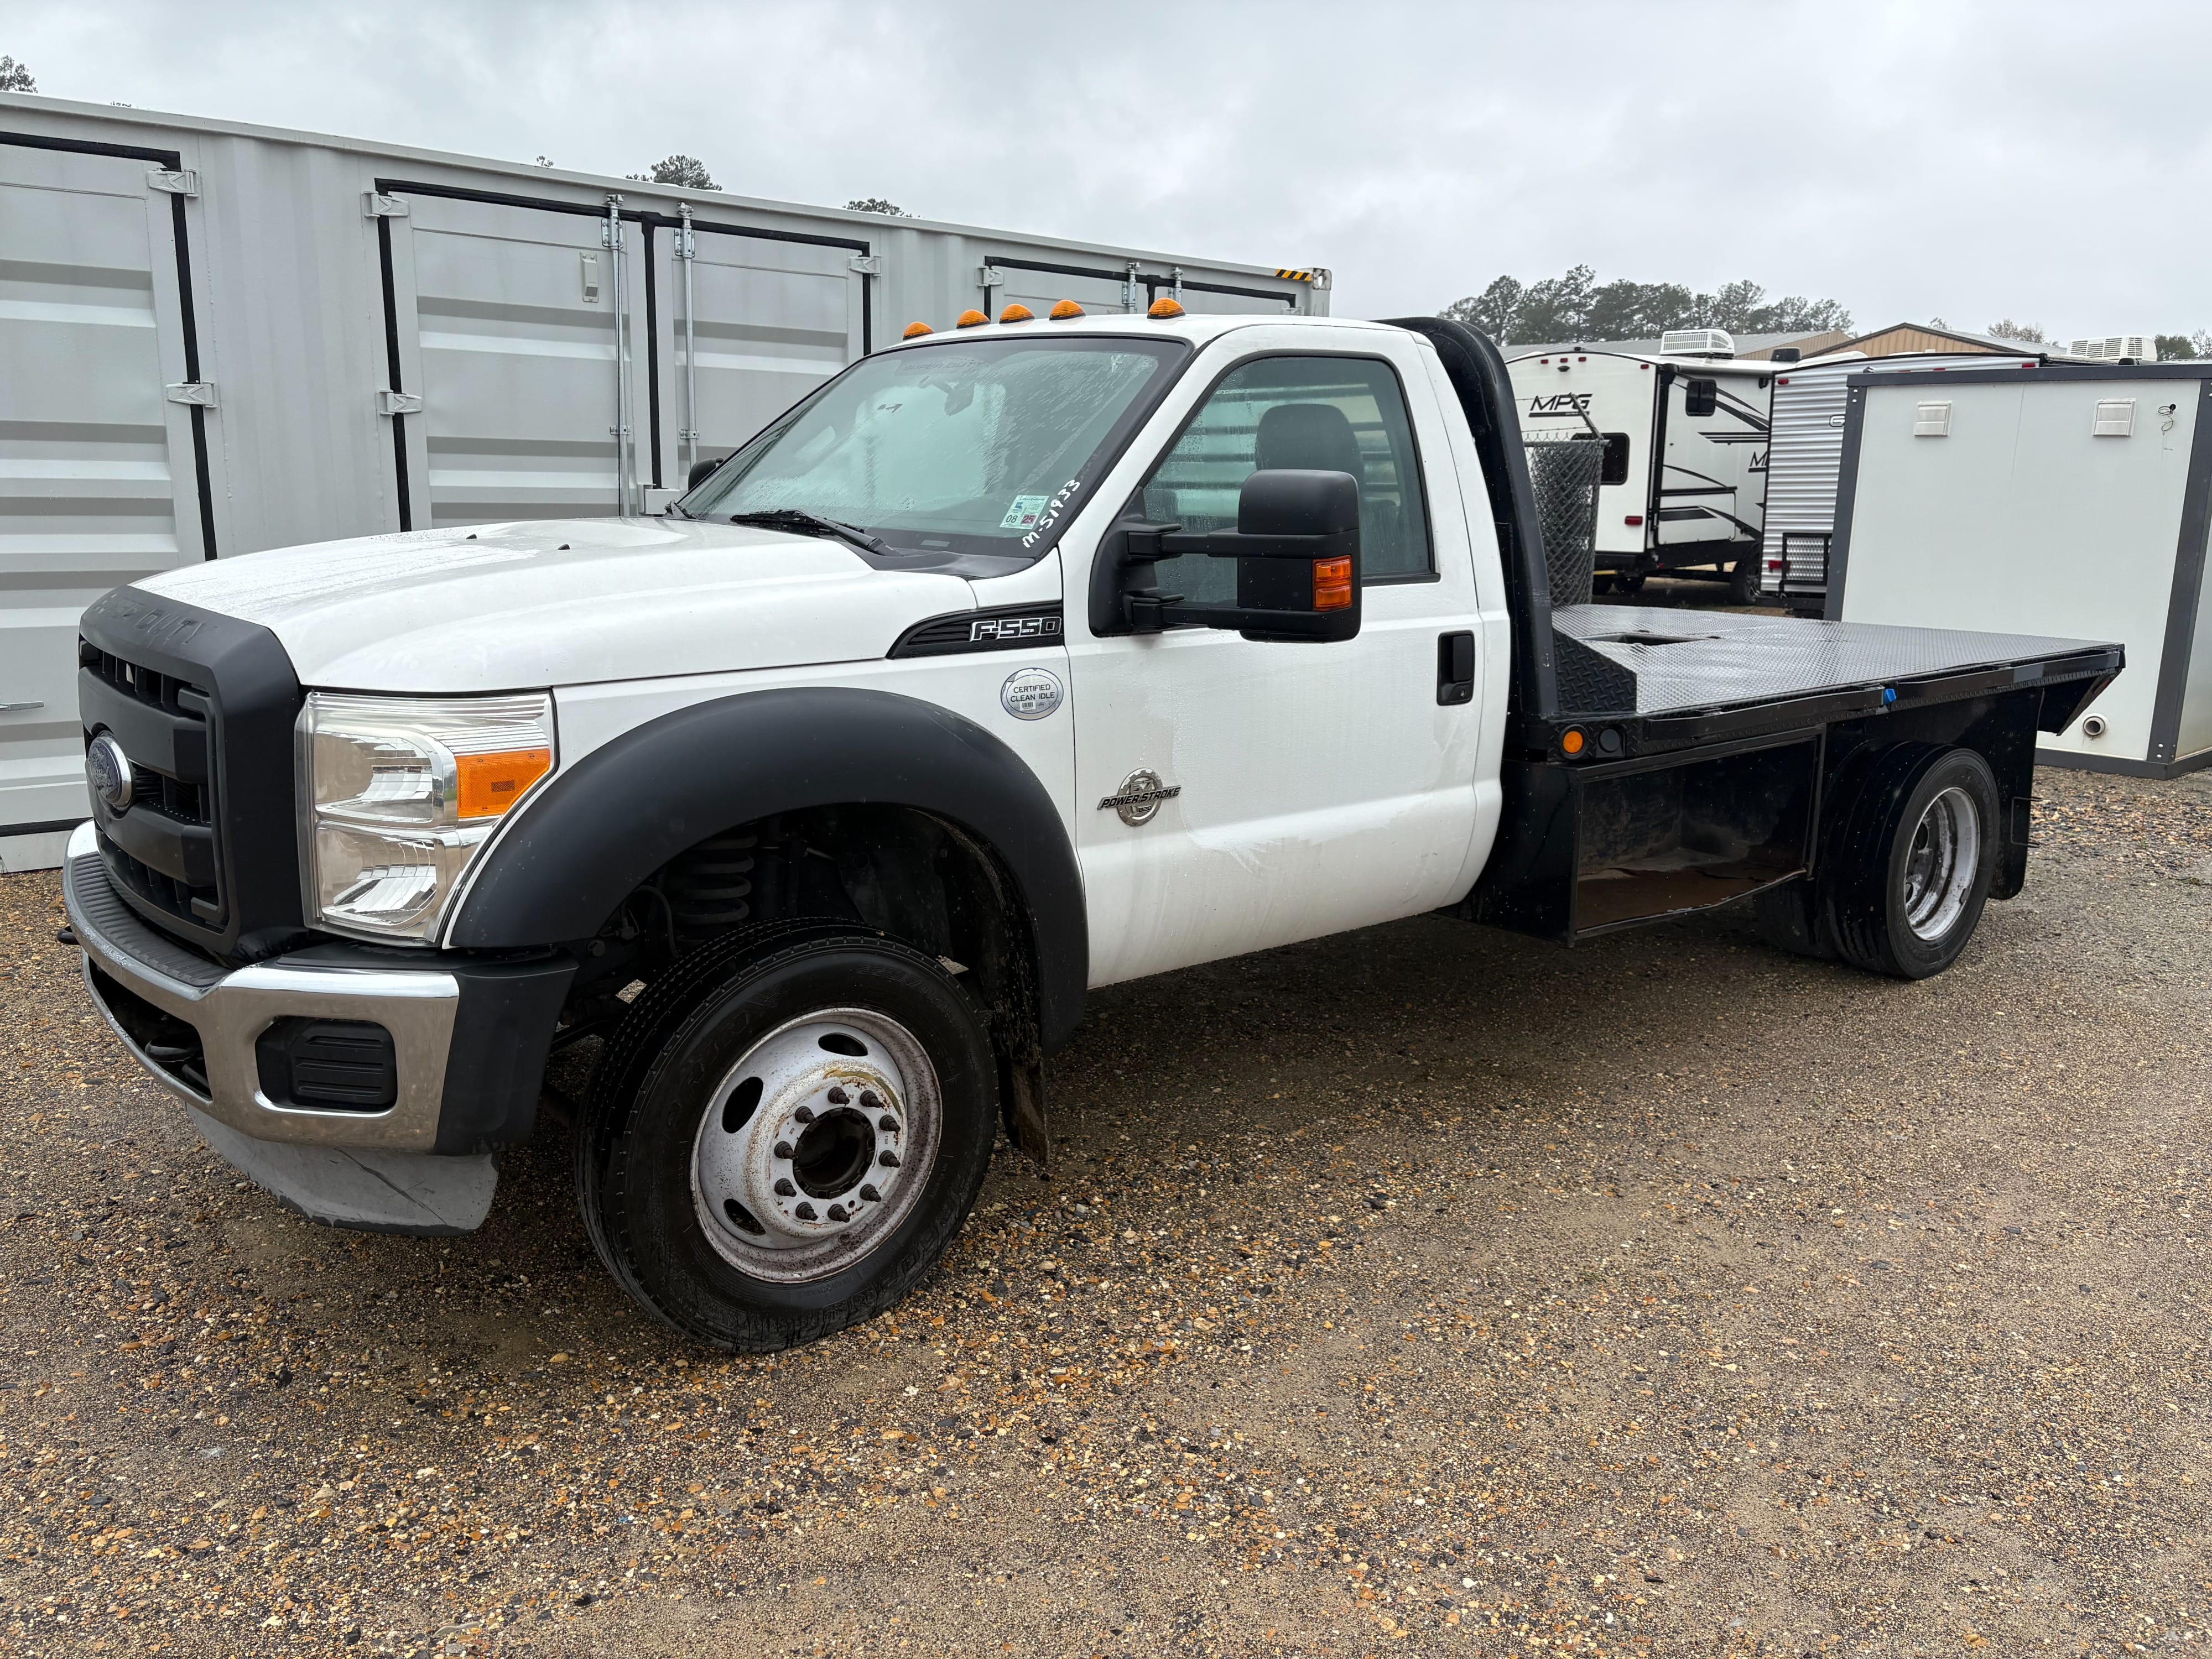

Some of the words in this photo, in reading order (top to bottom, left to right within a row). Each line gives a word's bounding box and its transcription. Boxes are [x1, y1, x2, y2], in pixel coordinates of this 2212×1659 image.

[1529, 393, 1593, 411] MPG
[1006, 515, 1018, 523] 08
[1022, 515, 1035, 524] 25
[970, 617, 1061, 642] F-550
[1013, 684, 1051, 693] CERTIFIED
[1010, 694, 1035, 702] CLEAN
